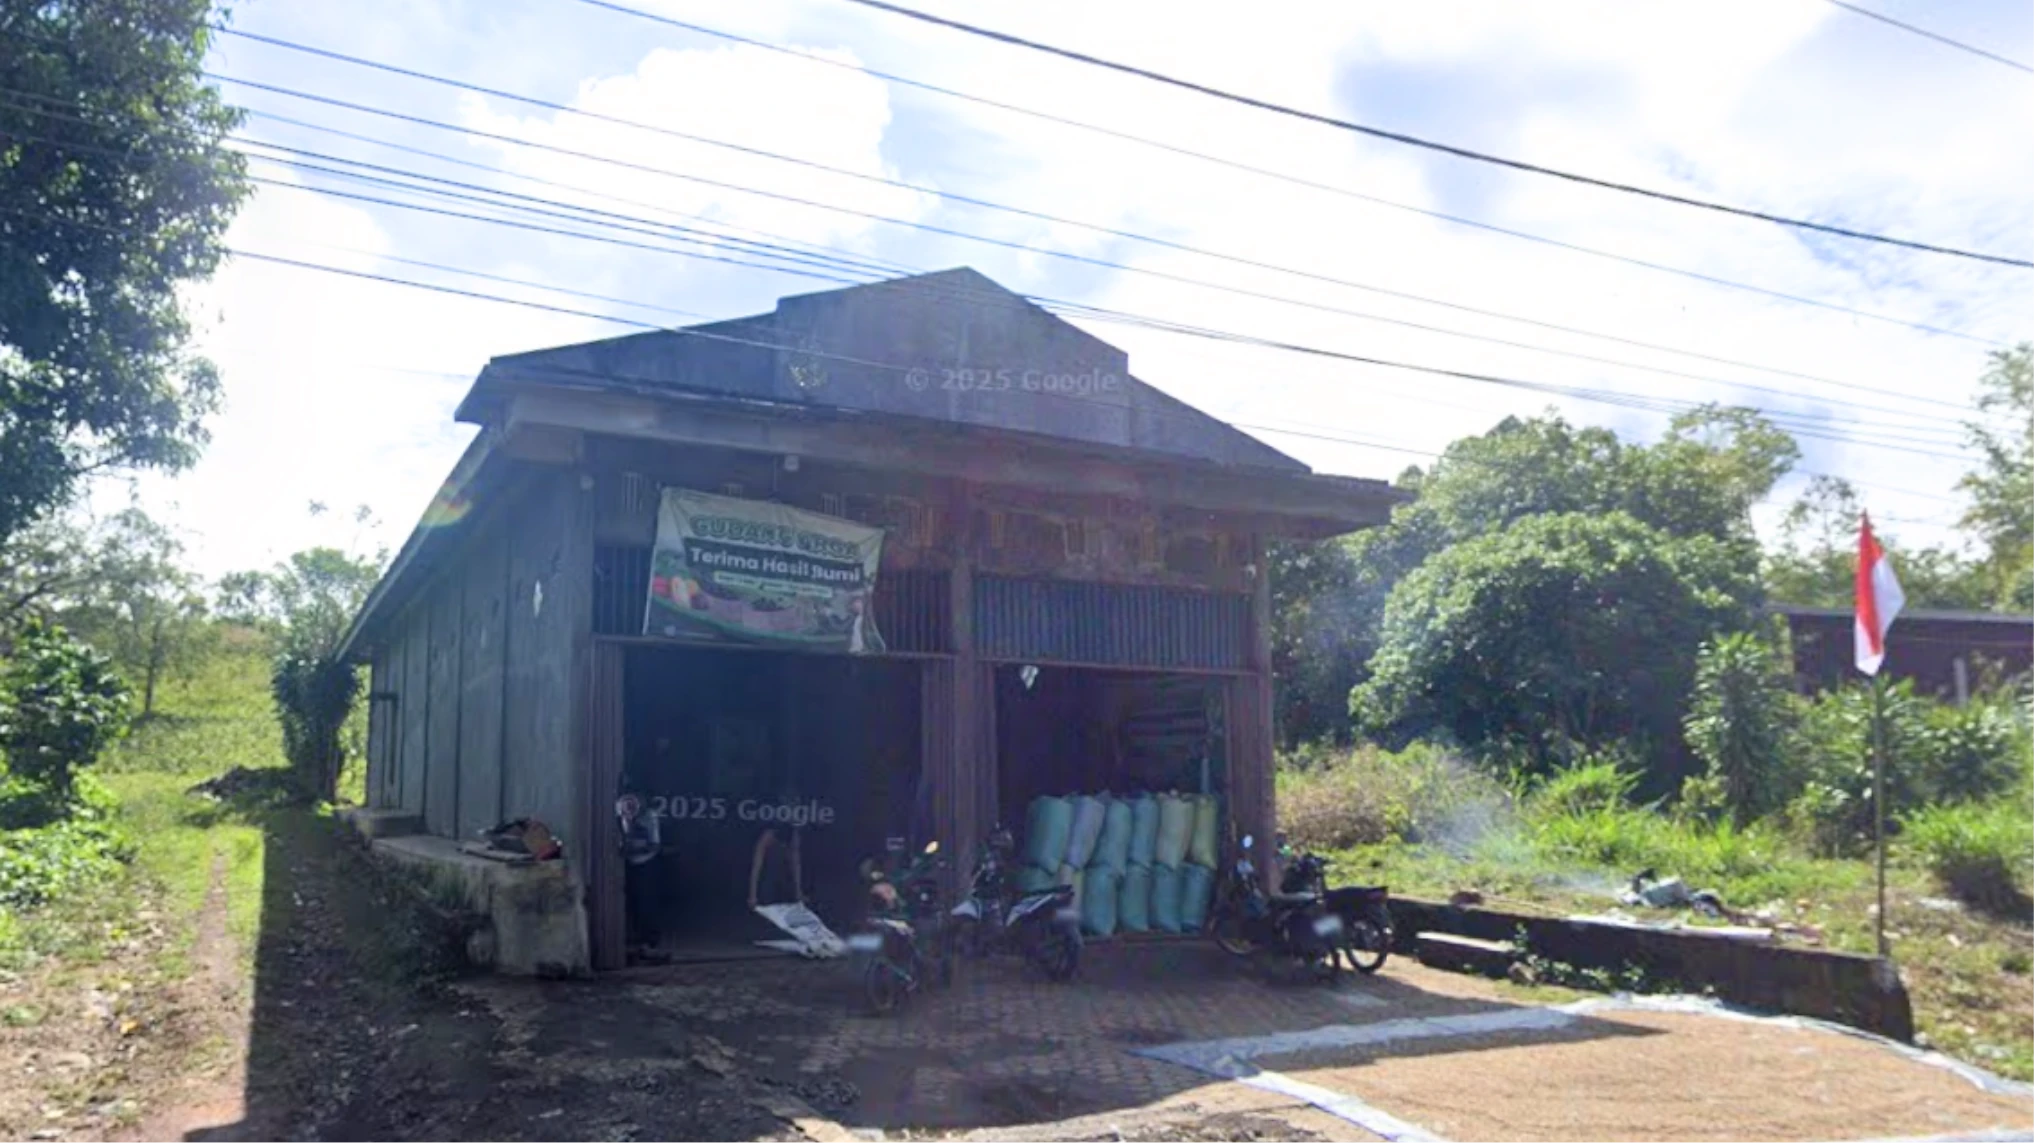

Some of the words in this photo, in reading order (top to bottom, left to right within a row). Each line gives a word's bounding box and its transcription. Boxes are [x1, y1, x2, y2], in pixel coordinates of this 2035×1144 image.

[692, 549, 759, 570] Terima
[762, 557, 808, 577] Hasil
[812, 565, 861, 583] Bumi
